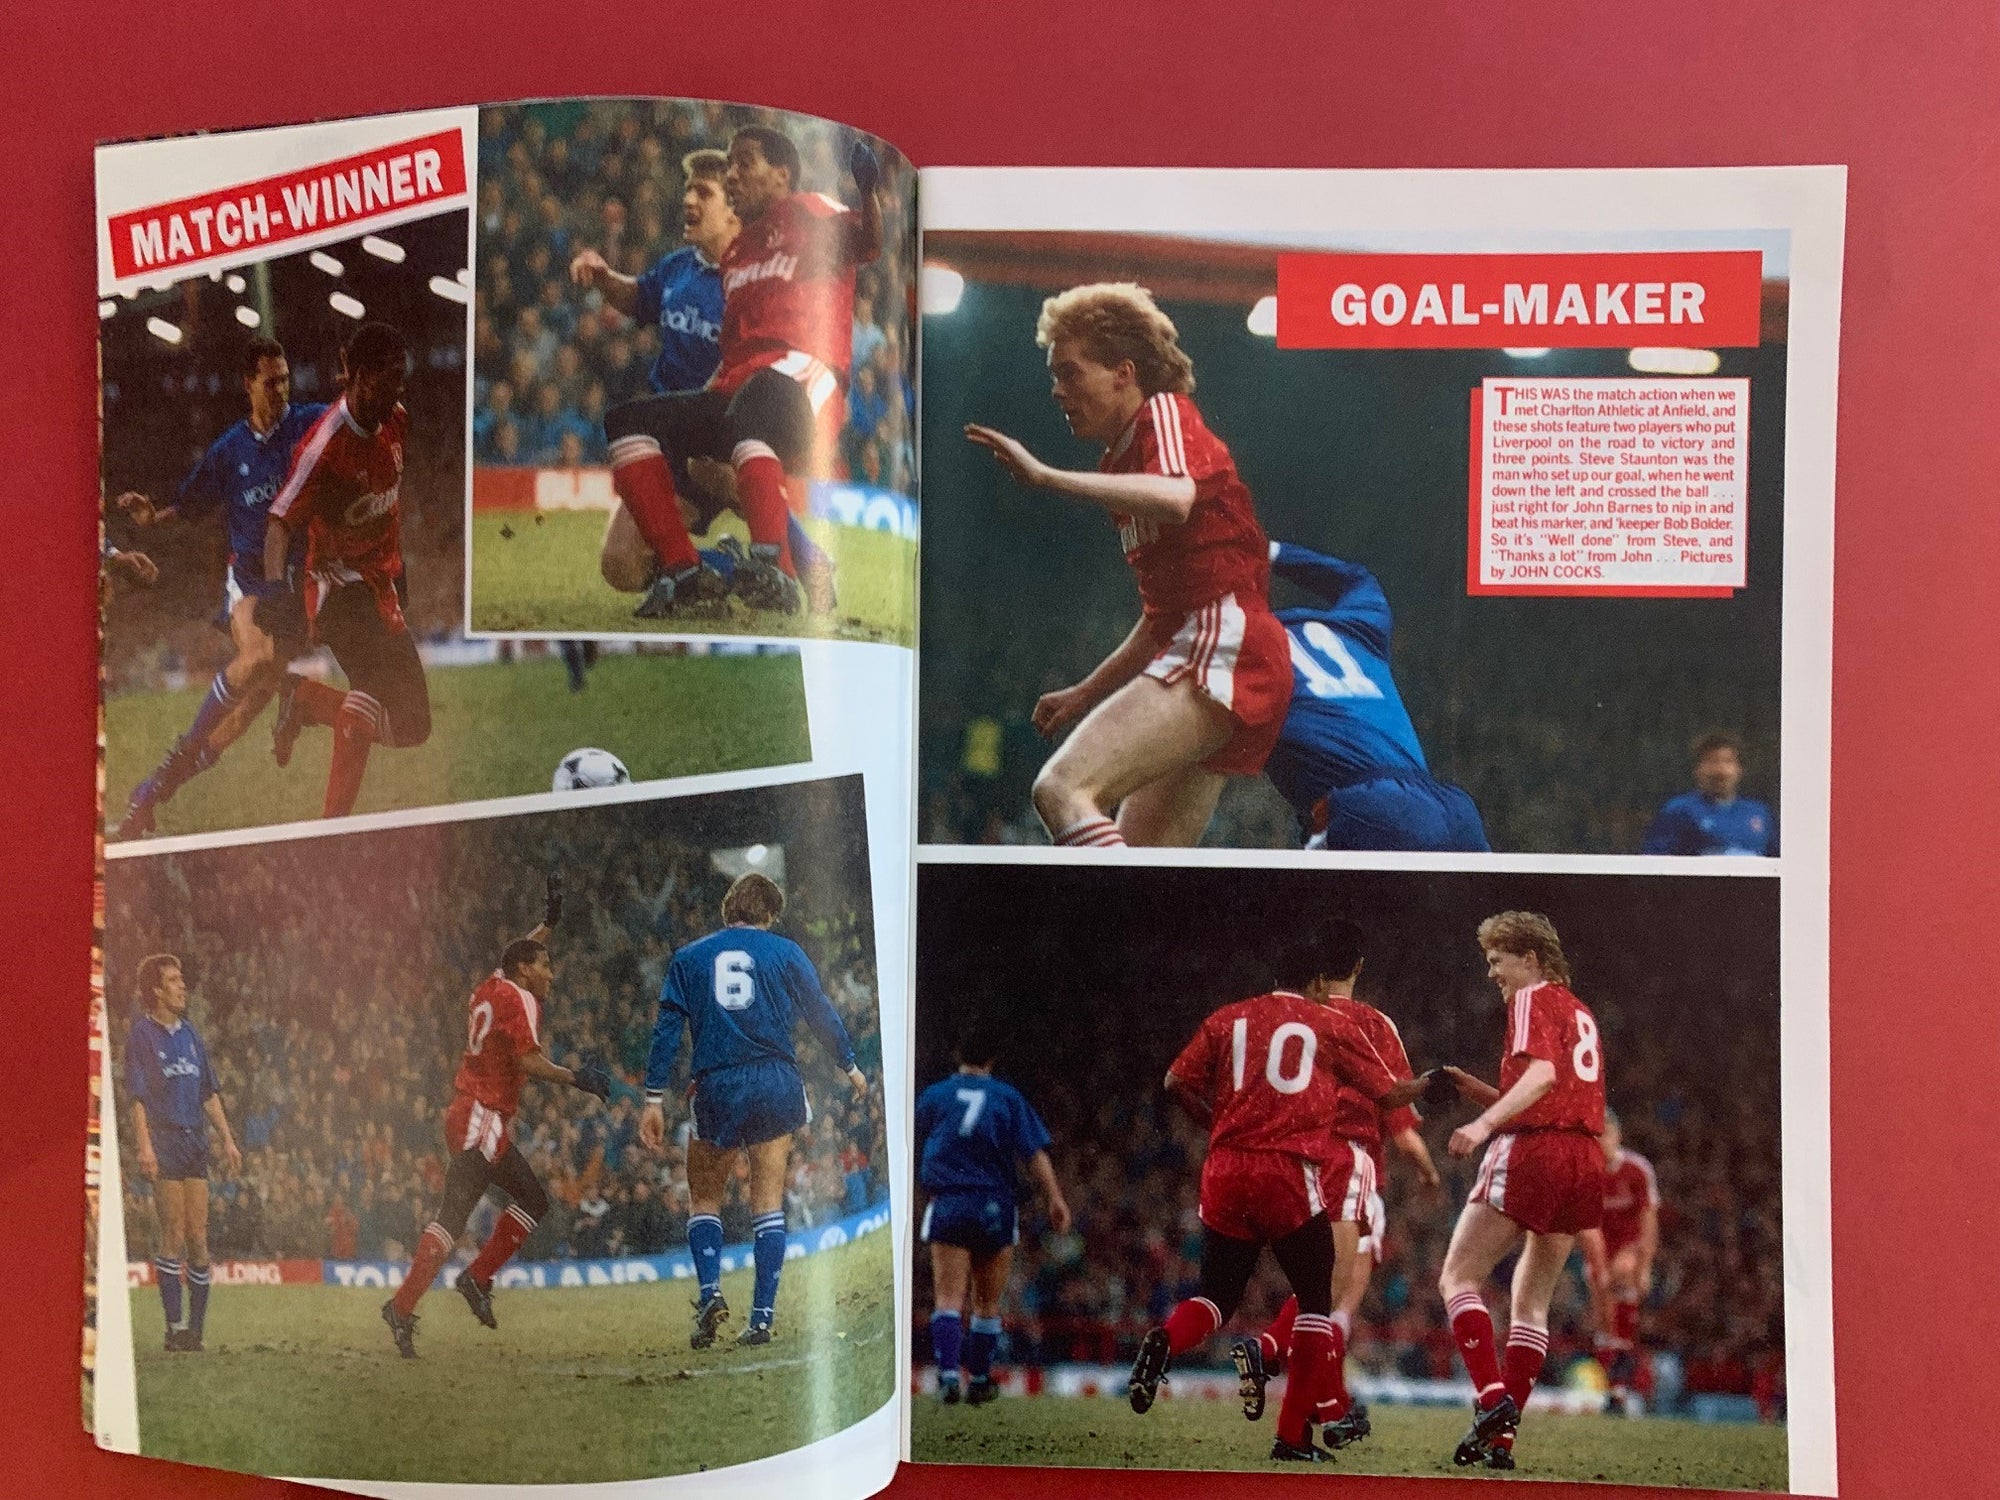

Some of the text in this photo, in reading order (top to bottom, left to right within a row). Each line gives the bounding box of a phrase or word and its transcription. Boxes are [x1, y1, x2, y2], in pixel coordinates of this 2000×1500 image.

[130, 148, 443, 267] MATCH-WINNER
[1330, 281, 1707, 327] GOAL-MAKER
[1541, 388, 1570, 401] WAS
[1573, 388, 1593, 401] the
[1597, 388, 1635, 401] match
[1638, 388, 1677, 401] action
[1680, 388, 1715, 401] when
[1718, 391, 1736, 401] we
[1514, 404, 1736, 418] met Charlton Athletic at Anfield, and
[1493, 420, 1735, 435] these shots feature two players who put
[1493, 436, 1735, 452] Liverpool on the road to victory and
[1493, 452, 1735, 467] three points. Steve Staunton was the
[1492, 468, 1734, 484] man who set up our goal, when he went
[1492, 484, 1525, 497] down
[1530, 484, 1551, 497] the
[1555, 484, 1575, 497] left
[1580, 484, 1603, 497] and
[1608, 484, 1656, 497] crossed
[1661, 484, 1681, 497] the
[1686, 484, 1709, 497] ball
[1491, 501, 1734, 516] just right for John Barnes to nip in and
[1491, 517, 1518, 529] beat
[1521, 517, 1538, 529] his
[1541, 517, 1587, 531] marker,
[1590, 517, 1613, 529] and
[1663, 517, 1688, 529] Bob
[1691, 517, 1733, 529] Bolder.
[1491, 534, 1508, 546] So
[1627, 534, 1655, 546] from
[1663, 534, 1702, 548] Steve,
[1709, 534, 1733, 546] and
[1548, 553, 1556, 562] a
[1588, 550, 1616, 562] from
[1620, 550, 1652, 562] John
[1680, 550, 1733, 562] Pictures
[1490, 565, 1604, 580] by JOHN COCKS.
[714, 949, 756, 1010] 6
[1571, 1009, 1600, 1083] 8
[1231, 1016, 1317, 1095] 10
[956, 1087, 986, 1136] 7
